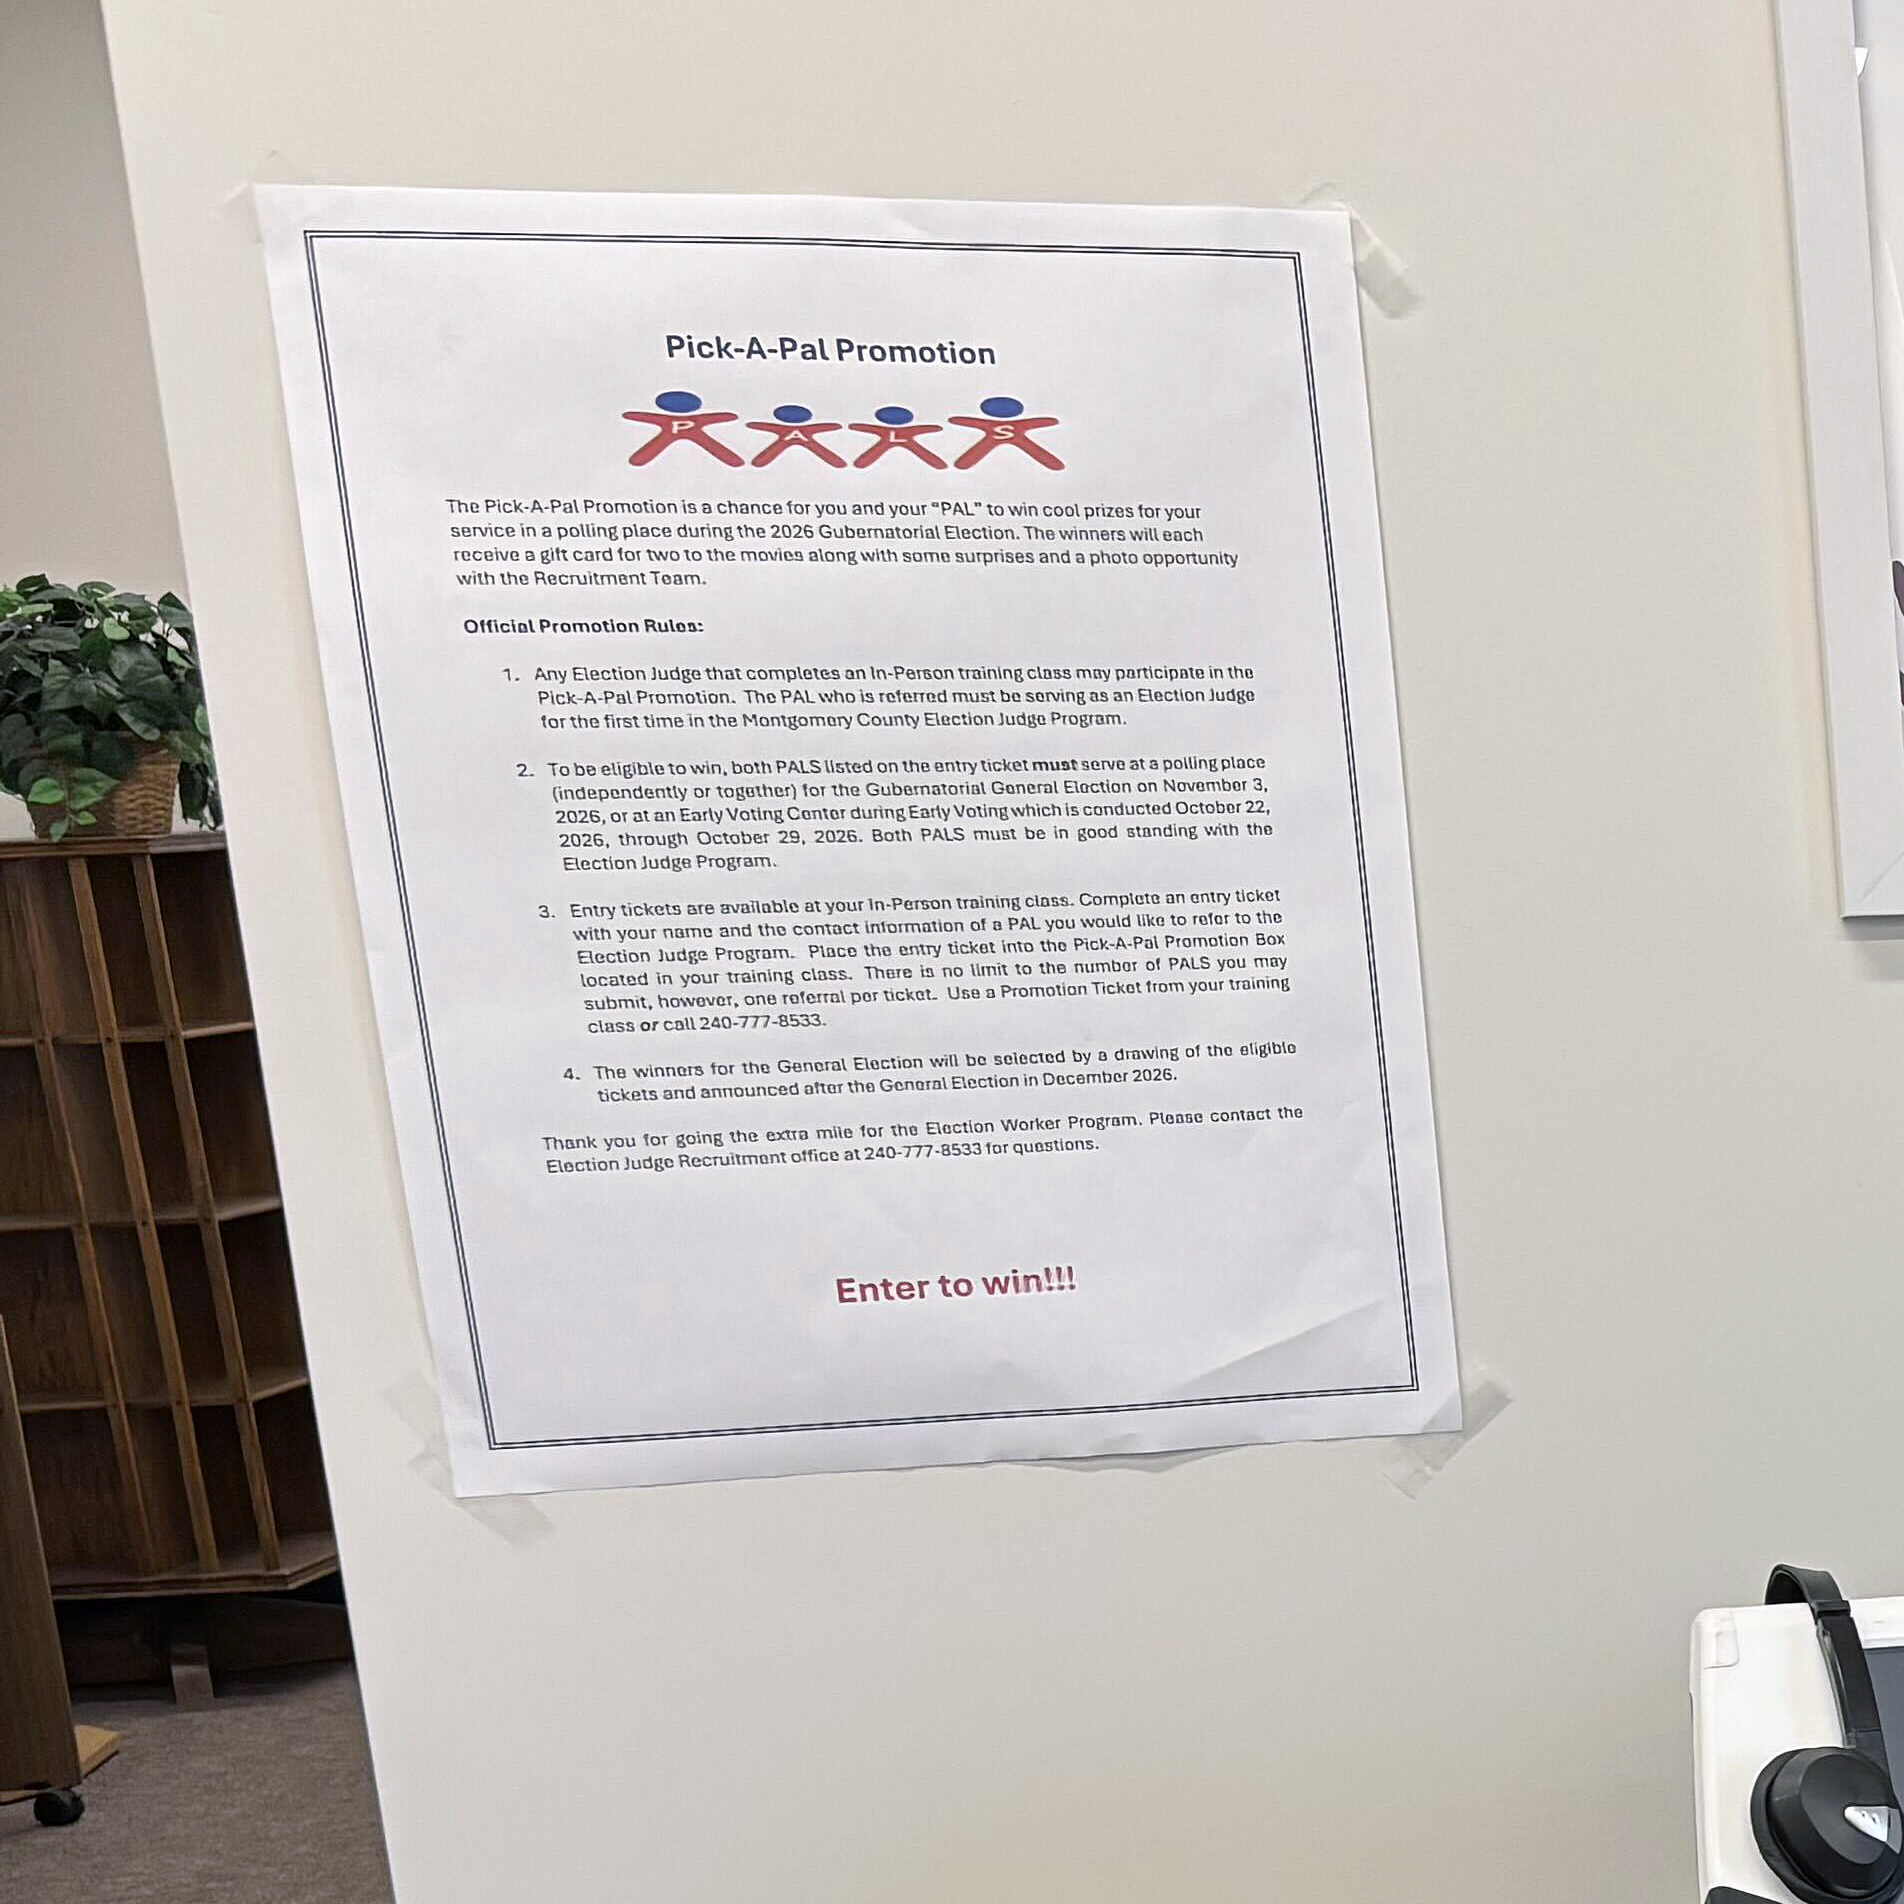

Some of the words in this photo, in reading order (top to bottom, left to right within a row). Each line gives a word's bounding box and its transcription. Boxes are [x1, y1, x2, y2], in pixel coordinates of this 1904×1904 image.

[665, 334, 830, 361] Pick-A-Pal
[835, 337, 996, 365] Promotion
[672, 421, 695, 434] P
[785, 430, 809, 442] A
[889, 431, 909, 443] L
[992, 425, 1015, 440] S
[444, 498, 480, 514] The
[484, 498, 580, 514] Pick-A-Pal
[583, 498, 678, 514] Promotion
[680, 499, 698, 515] is
[701, 502, 713, 515] a
[716, 500, 783, 515] chance
[785, 500, 812, 515] for
[814, 503, 848, 519] you
[851, 501, 885, 516] and
[888, 504, 928, 519] your
[986, 503, 1005, 517] to
[1007, 501, 1039, 517] win
[1042, 503, 1081, 518] cool
[1083, 503, 1135, 521] prizes
[1137, 503, 1162, 519] for
[1163, 507, 1202, 522] your
[450, 522, 516, 538] service
[519, 522, 537, 538] in
[540, 526, 553, 538] a
[556, 522, 620, 542] polling
[621, 523, 672, 541] place
[676, 522, 735, 542] during
[736, 523, 766, 539] the
[770, 523, 815, 539] 2026
[818, 524, 941, 540] Gubernatorial
[943, 525, 1021, 541] Election.
[1022, 525, 1056, 541] The
[1058, 526, 1126, 542] winners
[1129, 527, 1160, 542] will
[1162, 527, 1204, 542] each
[453, 547, 520, 562] receive
[524, 550, 536, 562] a
[539, 547, 569, 565] gift
[572, 546, 614, 562] card
[616, 546, 642, 562] for
[645, 548, 681, 562] two
[683, 549, 703, 562] to
[705, 547, 737, 562] the
[740, 547, 804, 562] movies
[808, 548, 859, 566] along
[859, 548, 899, 563] with
[901, 551, 951, 563] some
[954, 548, 1035, 567] surprises
[1038, 549, 1071, 564] and
[1075, 552, 1086, 564] a
[1089, 549, 1139, 567] photo
[1142, 551, 1239, 569] opportunity
[455, 570, 496, 586] with
[499, 571, 529, 586] the
[533, 570, 648, 586] Recruitment
[648, 570, 707, 586] Team.
[463, 618, 536, 634] Official
[538, 618, 640, 634] Promotion
[643, 618, 705, 633] Rules:
[540, 714, 567, 729] for
[569, 714, 600, 729] the
[603, 713, 641, 729] first
[643, 714, 685, 729] time
[686, 713, 705, 728] in
[707, 713, 738, 728] the
[741, 713, 853, 731] Montgomery
[856, 712, 920, 730] County
[923, 711, 995, 727] Election
[997, 711, 1047, 729] Judge
[1049, 711, 1127, 729] Program.
[558, 832, 610, 849] 2026,
[617, 831, 689, 849] through
[696, 830, 770, 846] October
[777, 829, 806, 846] 29,
[813, 829, 863, 844] 2026.
[871, 828, 913, 843] Both
[920, 826, 966, 842] PALS
[972, 828, 1017, 841] must
[1024, 826, 1046, 840] be
[1053, 825, 1069, 840] in
[1077, 825, 1118, 842] good
[1126, 822, 1199, 841] standing
[1203, 822, 1239, 837] with
[1246, 822, 1273, 836] the
[597, 1088, 659, 1103] tickets
[662, 1085, 696, 1101] and
[700, 1081, 800, 1099] announced
[803, 1081, 844, 1095] after
[846, 1079, 876, 1094] the
[879, 1076, 949, 1093] General
[951, 1074, 1020, 1090] Election
[1022, 1073, 1039, 1087] in
[1042, 1070, 1129, 1086] December
[1132, 1067, 1178, 1083] 2026.
[546, 1157, 620, 1174] Election
[623, 1155, 675, 1173] Judge
[677, 1151, 788, 1168] Recruitment
[790, 1148, 840, 1164] office
[843, 1148, 861, 1161] at
[863, 1141, 983, 1161] 240-777-8533
[985, 1141, 1009, 1155] for
[1012, 1137, 1100, 1157] questions.
[835, 1277, 931, 1304] Enter
[937, 1275, 974, 1298] to
[980, 1265, 1076, 1296] win!!!
